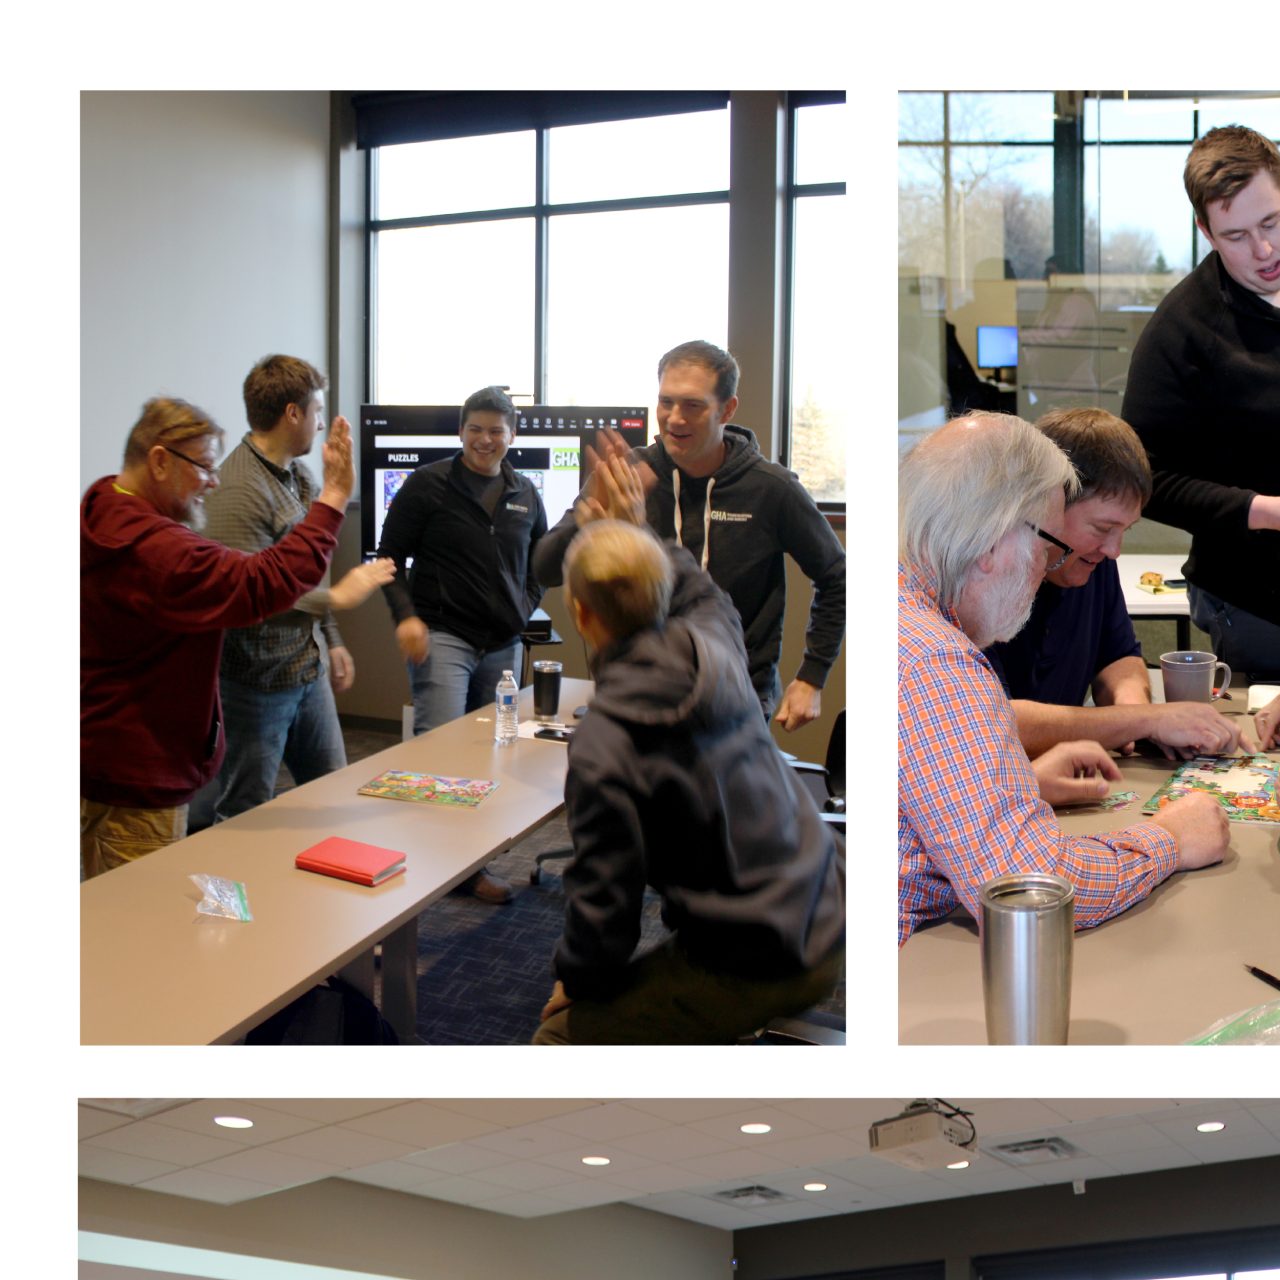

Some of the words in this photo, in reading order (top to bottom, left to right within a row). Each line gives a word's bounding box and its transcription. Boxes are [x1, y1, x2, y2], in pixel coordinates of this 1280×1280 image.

[388, 453, 419, 462] PUZZLES
[553, 451, 580, 467] GHA
[711, 510, 727, 521] GHA
